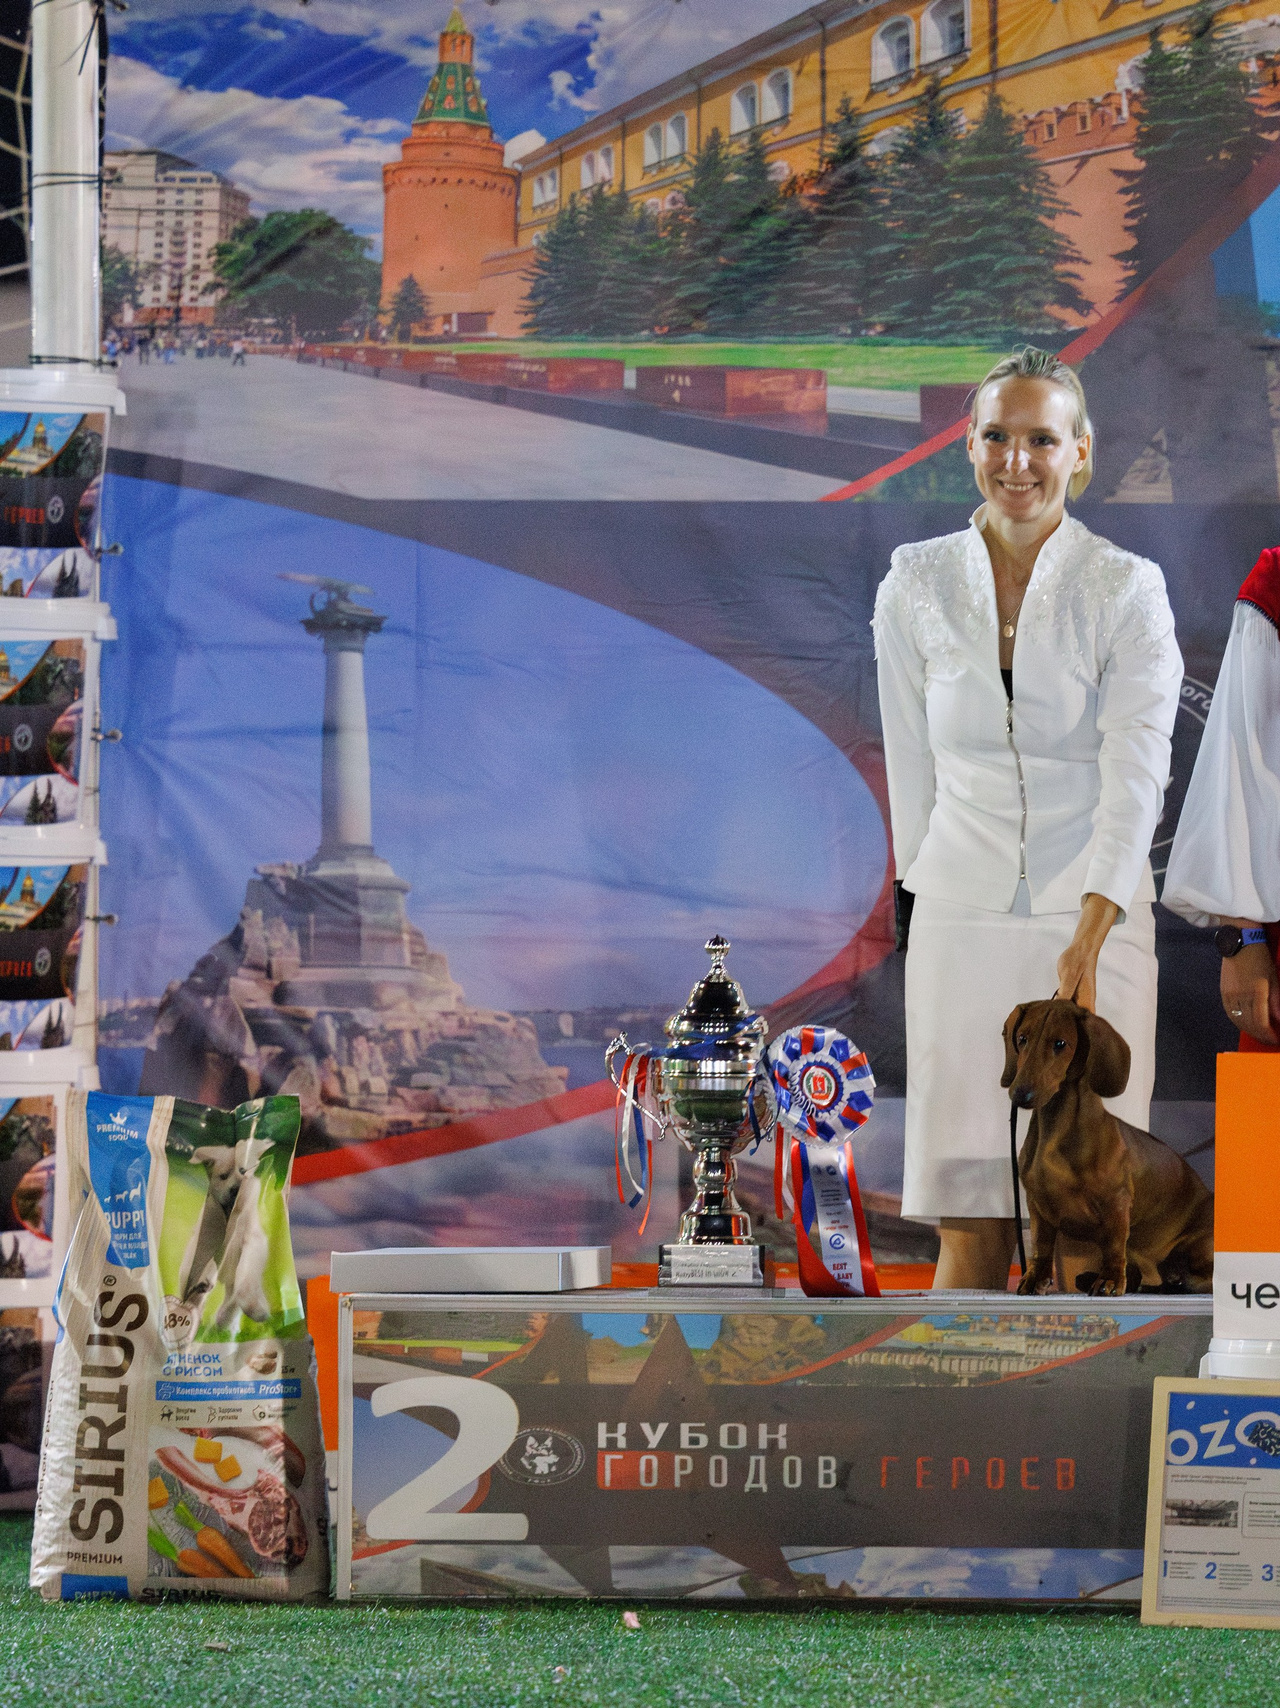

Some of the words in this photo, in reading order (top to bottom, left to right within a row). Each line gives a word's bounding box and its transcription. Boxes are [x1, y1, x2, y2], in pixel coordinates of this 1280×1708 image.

[96, 1124, 138, 1140] PREMIUM
[109, 1134, 129, 1142] FOOD
[175, 1365, 223, 1377] РИСОМ
[69, 1290, 149, 1544] SIRIUS
[597, 1422, 788, 1450] КУБОК
[366, 1375, 529, 1541] 2
[604, 1455, 838, 1493] ГОРОДОВ
[879, 1456, 1077, 1491] ГЕРОЕВ
[66, 1550, 123, 1565] PREMIUM
[1204, 1561, 1217, 1580] 2
[1261, 1563, 1274, 1582] 3
